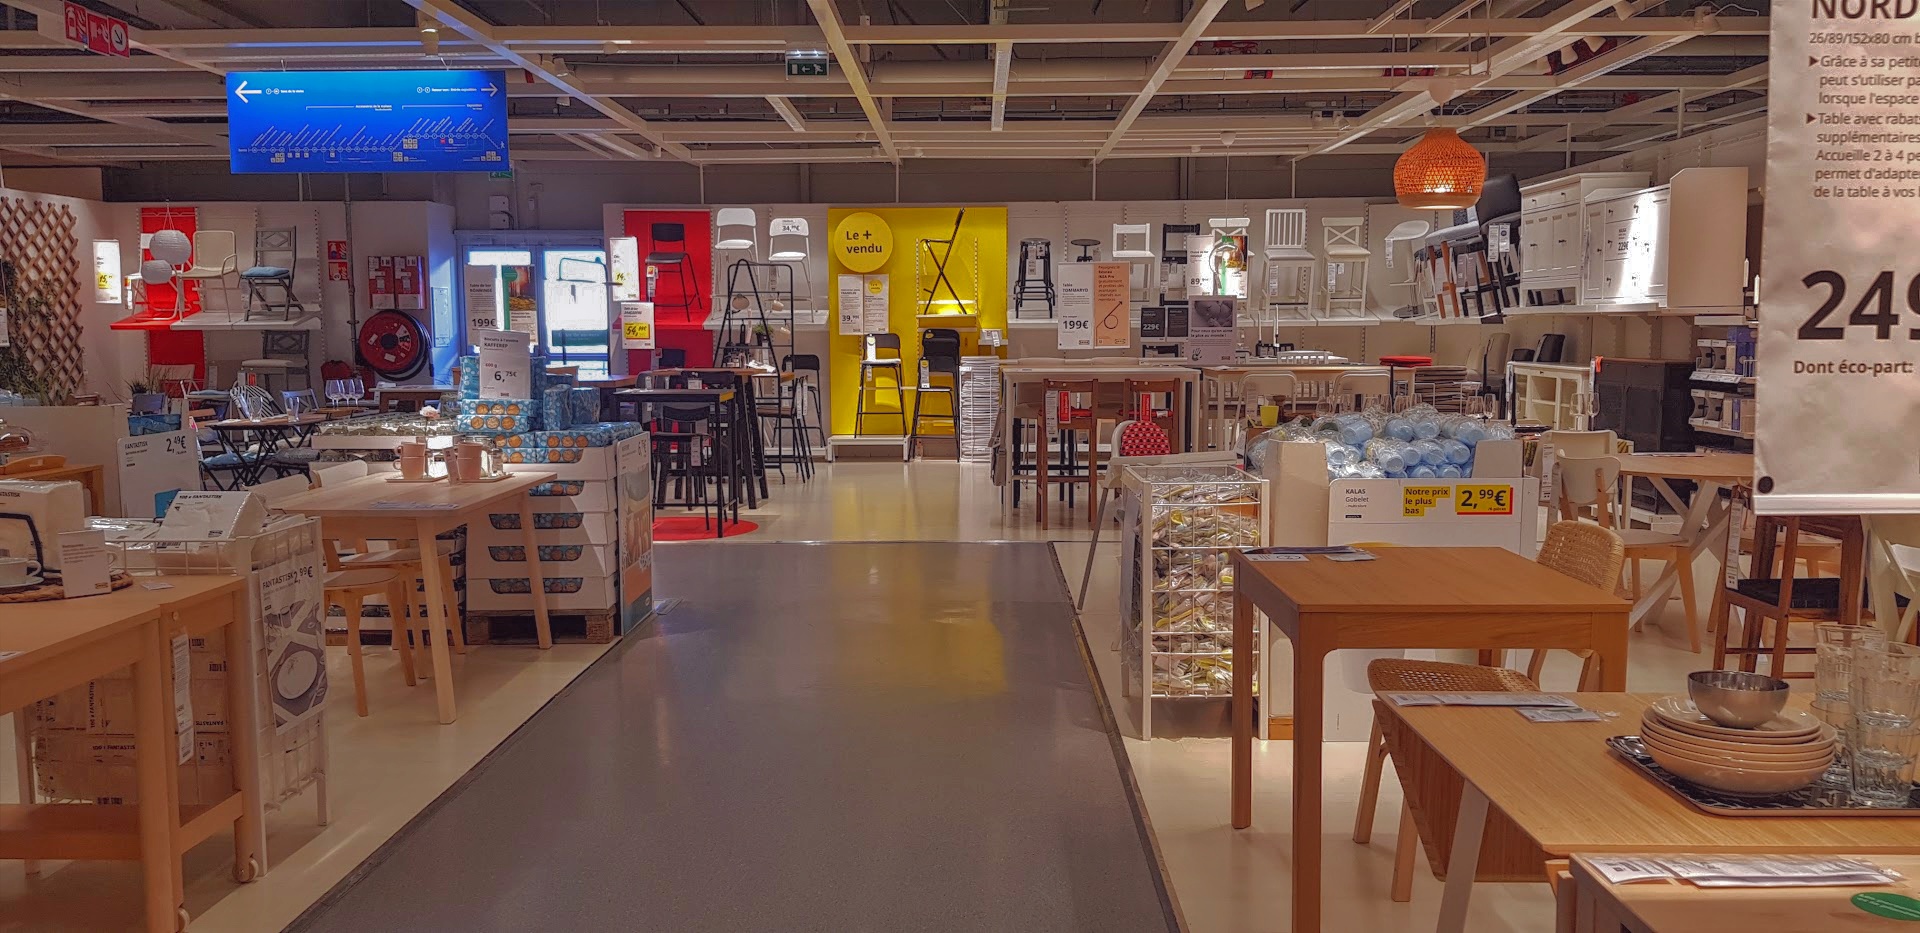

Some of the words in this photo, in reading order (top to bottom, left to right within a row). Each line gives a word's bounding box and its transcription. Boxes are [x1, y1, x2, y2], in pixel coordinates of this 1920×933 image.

[1810, 32, 1890, 44] 26/89/152x80
[1892, 34, 1912, 44] cm
[1820, 56, 1856, 68] Grâce
[1860, 56, 1868, 67] à
[1871, 58, 1885, 67] sa
[1820, 77, 1848, 88] peut
[1852, 74, 1903, 86] s'utiliser
[1819, 93, 1865, 107] lorsque
[1870, 93, 1918, 107] l'espace
[1818, 113, 1850, 125] Table
[1854, 116, 1882, 125] avec
[1816, 132, 1920, 145] supplémentaires
[1816, 150, 1870, 161] Accueille
[1873, 150, 1882, 161] 2
[1886, 149, 1892, 161] à
[1896, 150, 1904, 161] 4
[1815, 169, 1860, 182] permet
[1814, 187, 1830, 197] de
[1833, 187, 1844, 197] la
[1847, 187, 1878, 197] table
[1882, 186, 1890, 197] à
[1892, 189, 1915, 197] vos
[846, 231, 859, 240] Le
[863, 230, 872, 240] +
[846, 244, 882, 254] vendu
[1797, 270, 1920, 340] 24
[472, 319, 496, 327] 199€
[1063, 320, 1088, 329] 199€
[1794, 361, 1834, 373] Dont
[1838, 360, 1913, 377] éco-part:
[494, 371, 517, 382] 6,75€
[166, 436, 186, 453] 2,49€
[1432, 488, 1448, 498] prix
[1461, 489, 1507, 509] 2,99€
[1415, 498, 1432, 506] plus
[263, 572, 293, 590] FANTASTISK
[294, 566, 313, 584] 2,99€
